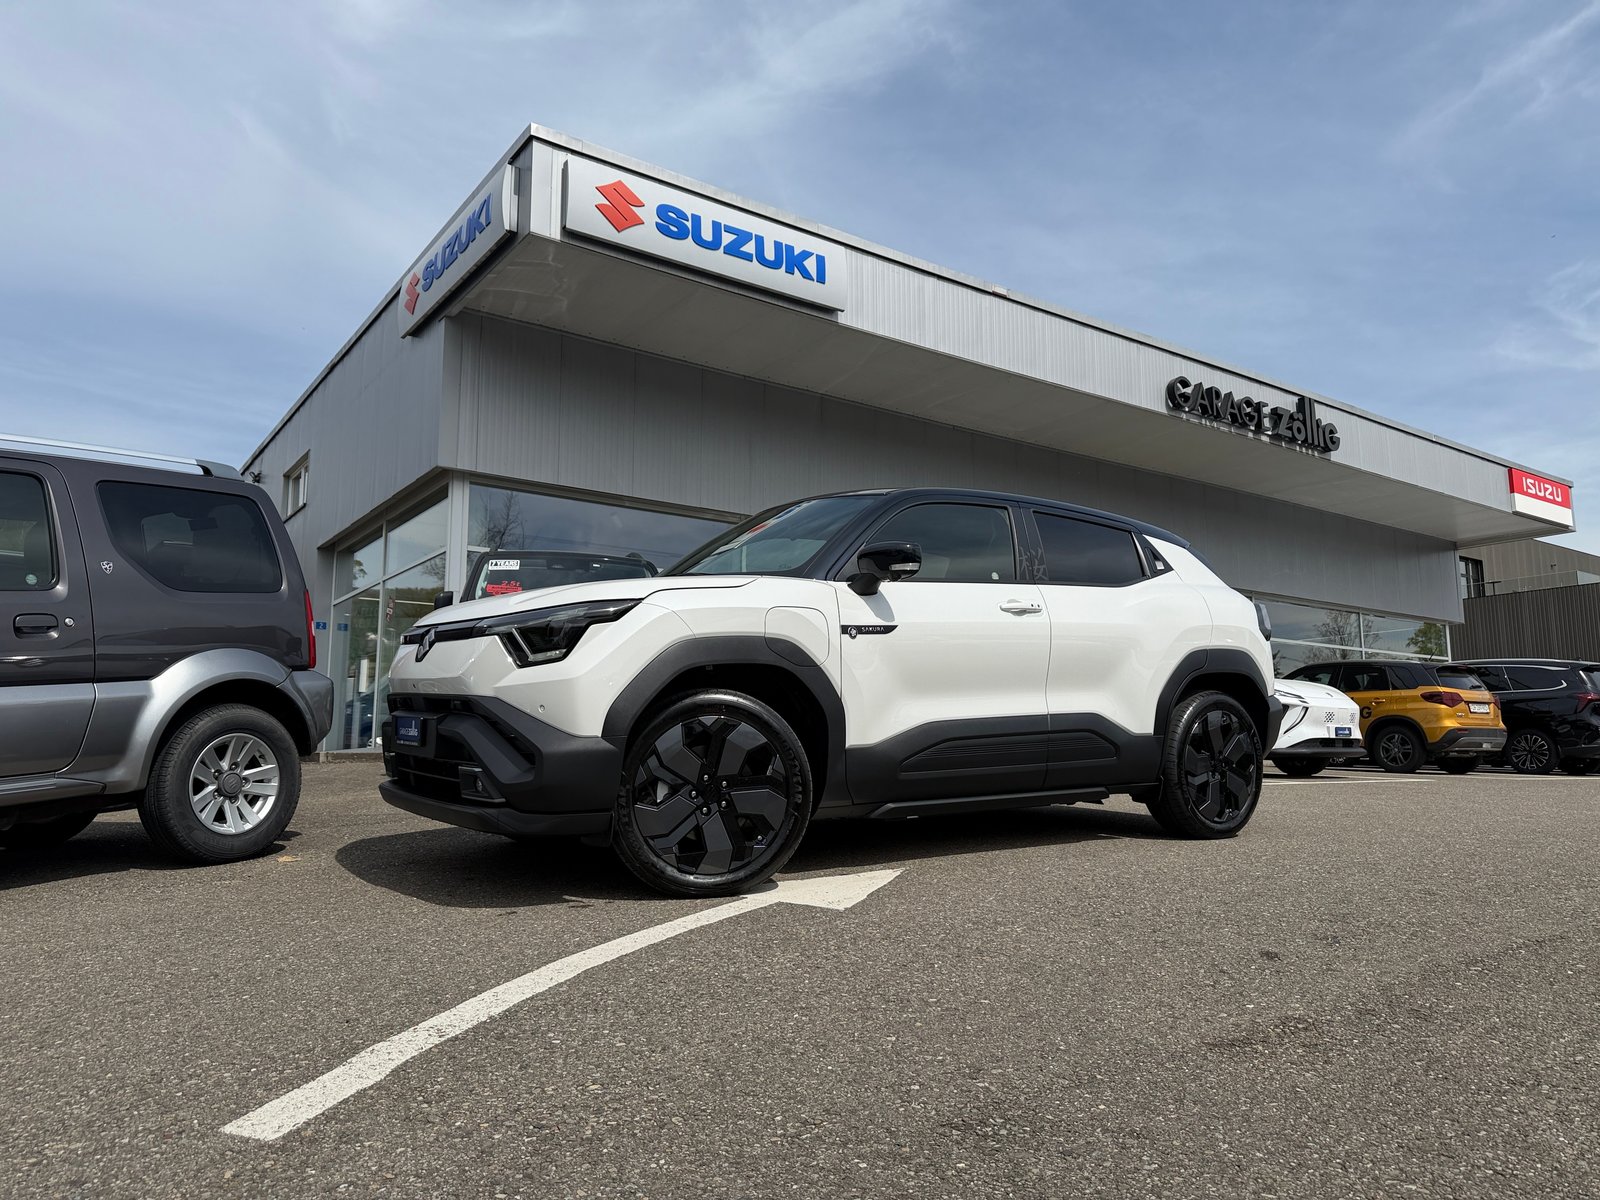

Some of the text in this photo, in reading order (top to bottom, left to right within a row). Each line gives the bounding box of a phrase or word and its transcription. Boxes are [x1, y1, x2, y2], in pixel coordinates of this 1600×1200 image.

[422, 192, 492, 292] SUZUKI
[655, 203, 826, 285] SUZUKI
[1166, 375, 1271, 433] GARAGE
[1522, 476, 1562, 502] ISUZU
